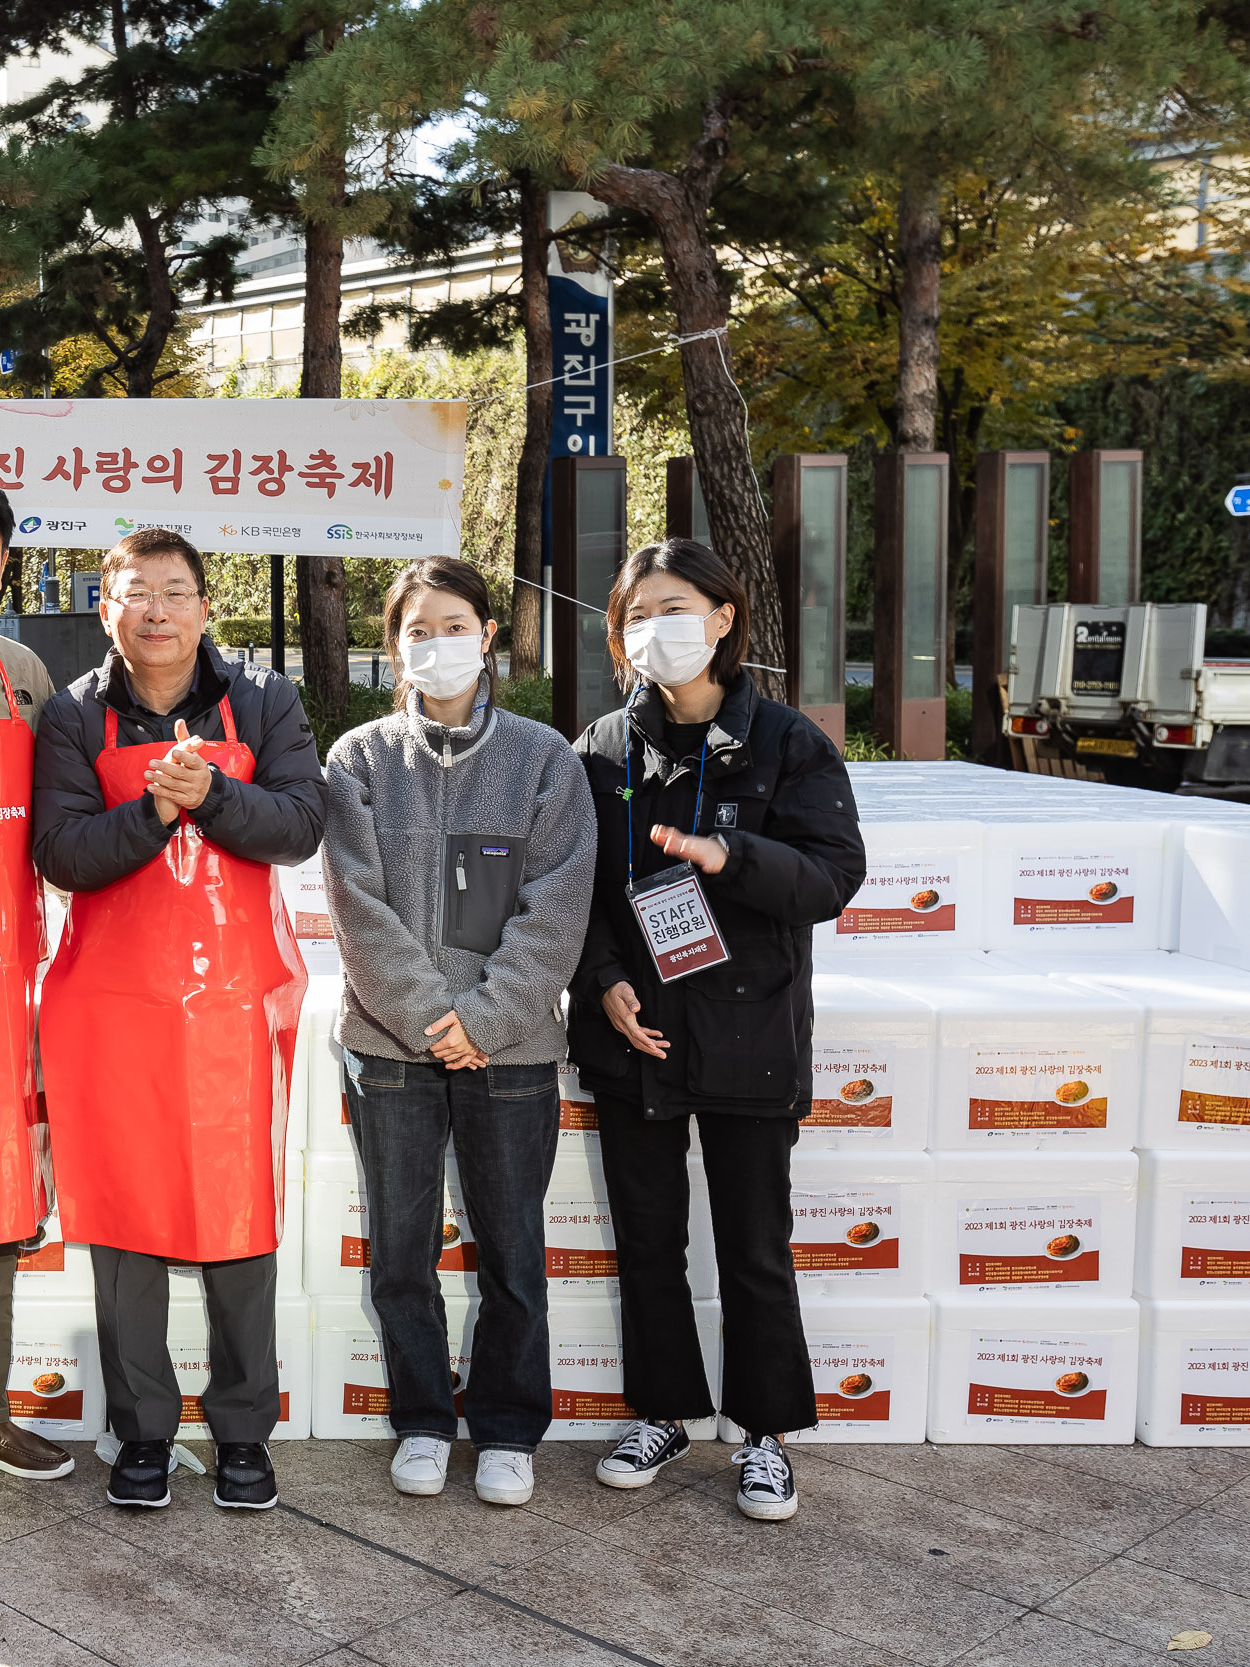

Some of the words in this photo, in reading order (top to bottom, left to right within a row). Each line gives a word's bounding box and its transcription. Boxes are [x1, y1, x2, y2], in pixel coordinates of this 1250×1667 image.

[42, 446, 183, 494] 사랑의
[203, 448, 394, 500] 김장축제
[46, 520, 87, 531] 광진구
[241, 526, 260, 536] KB
[262, 526, 301, 538] 국민은행
[355, 531, 423, 542] 한국사회보장정보원
[648, 899, 696, 929] STAFF
[652, 914, 707, 945] 진행요원
[670, 944, 708, 962] 광진복지재단
[824, 1064, 850, 1073] 사랑의
[853, 1064, 887, 1073] 김장축제
[1190, 1059, 1208, 1067] 2023
[1210, 1059, 1232, 1069] 제1회
[976, 1066, 994, 1074] 2023
[996, 1065, 1017, 1075] 제1회
[1020, 1065, 1036, 1075] 광진
[1038, 1065, 1065, 1075] 사랑의
[1068, 1065, 1102, 1074] 김장축제
[349, 1205, 367, 1213] 2023
[810, 1208, 827, 1218] 광진
[829, 1207, 855, 1216] 사랑의
[858, 1206, 892, 1216] 김장축제
[549, 1216, 567, 1224] 2023
[568, 1215, 590, 1224] 제1회
[593, 1215, 610, 1224] 광진
[965, 1223, 983, 1231] 2023
[985, 1221, 1006, 1231] 제1회
[1010, 1220, 1026, 1230] 광진
[1029, 1220, 1055, 1229] 사랑의
[1058, 1218, 1092, 1229] 김장축제
[1189, 1215, 1207, 1224] 2023
[1208, 1215, 1230, 1224] 제1회
[1233, 1215, 1250, 1225] 광진
[16, 1356, 42, 1366] 사랑의
[44, 1357, 78, 1368] 김장축제
[351, 1353, 369, 1361] 2023
[557, 1358, 575, 1366] 2023
[576, 1358, 598, 1367] 제1회
[600, 1358, 617, 1367] 광진
[977, 1353, 996, 1361] 2023
[997, 1353, 1018, 1362] 제1회
[1021, 1354, 1038, 1364] 광진
[1040, 1355, 1066, 1365] 사랑의
[1069, 1356, 1103, 1366] 김장축제
[823, 1358, 848, 1368] 사랑의
[851, 1358, 885, 1368] 김장축제
[1188, 1362, 1206, 1371] 2023
[1207, 1361, 1229, 1371] 제1회
[1232, 1361, 1249, 1372] 광진
